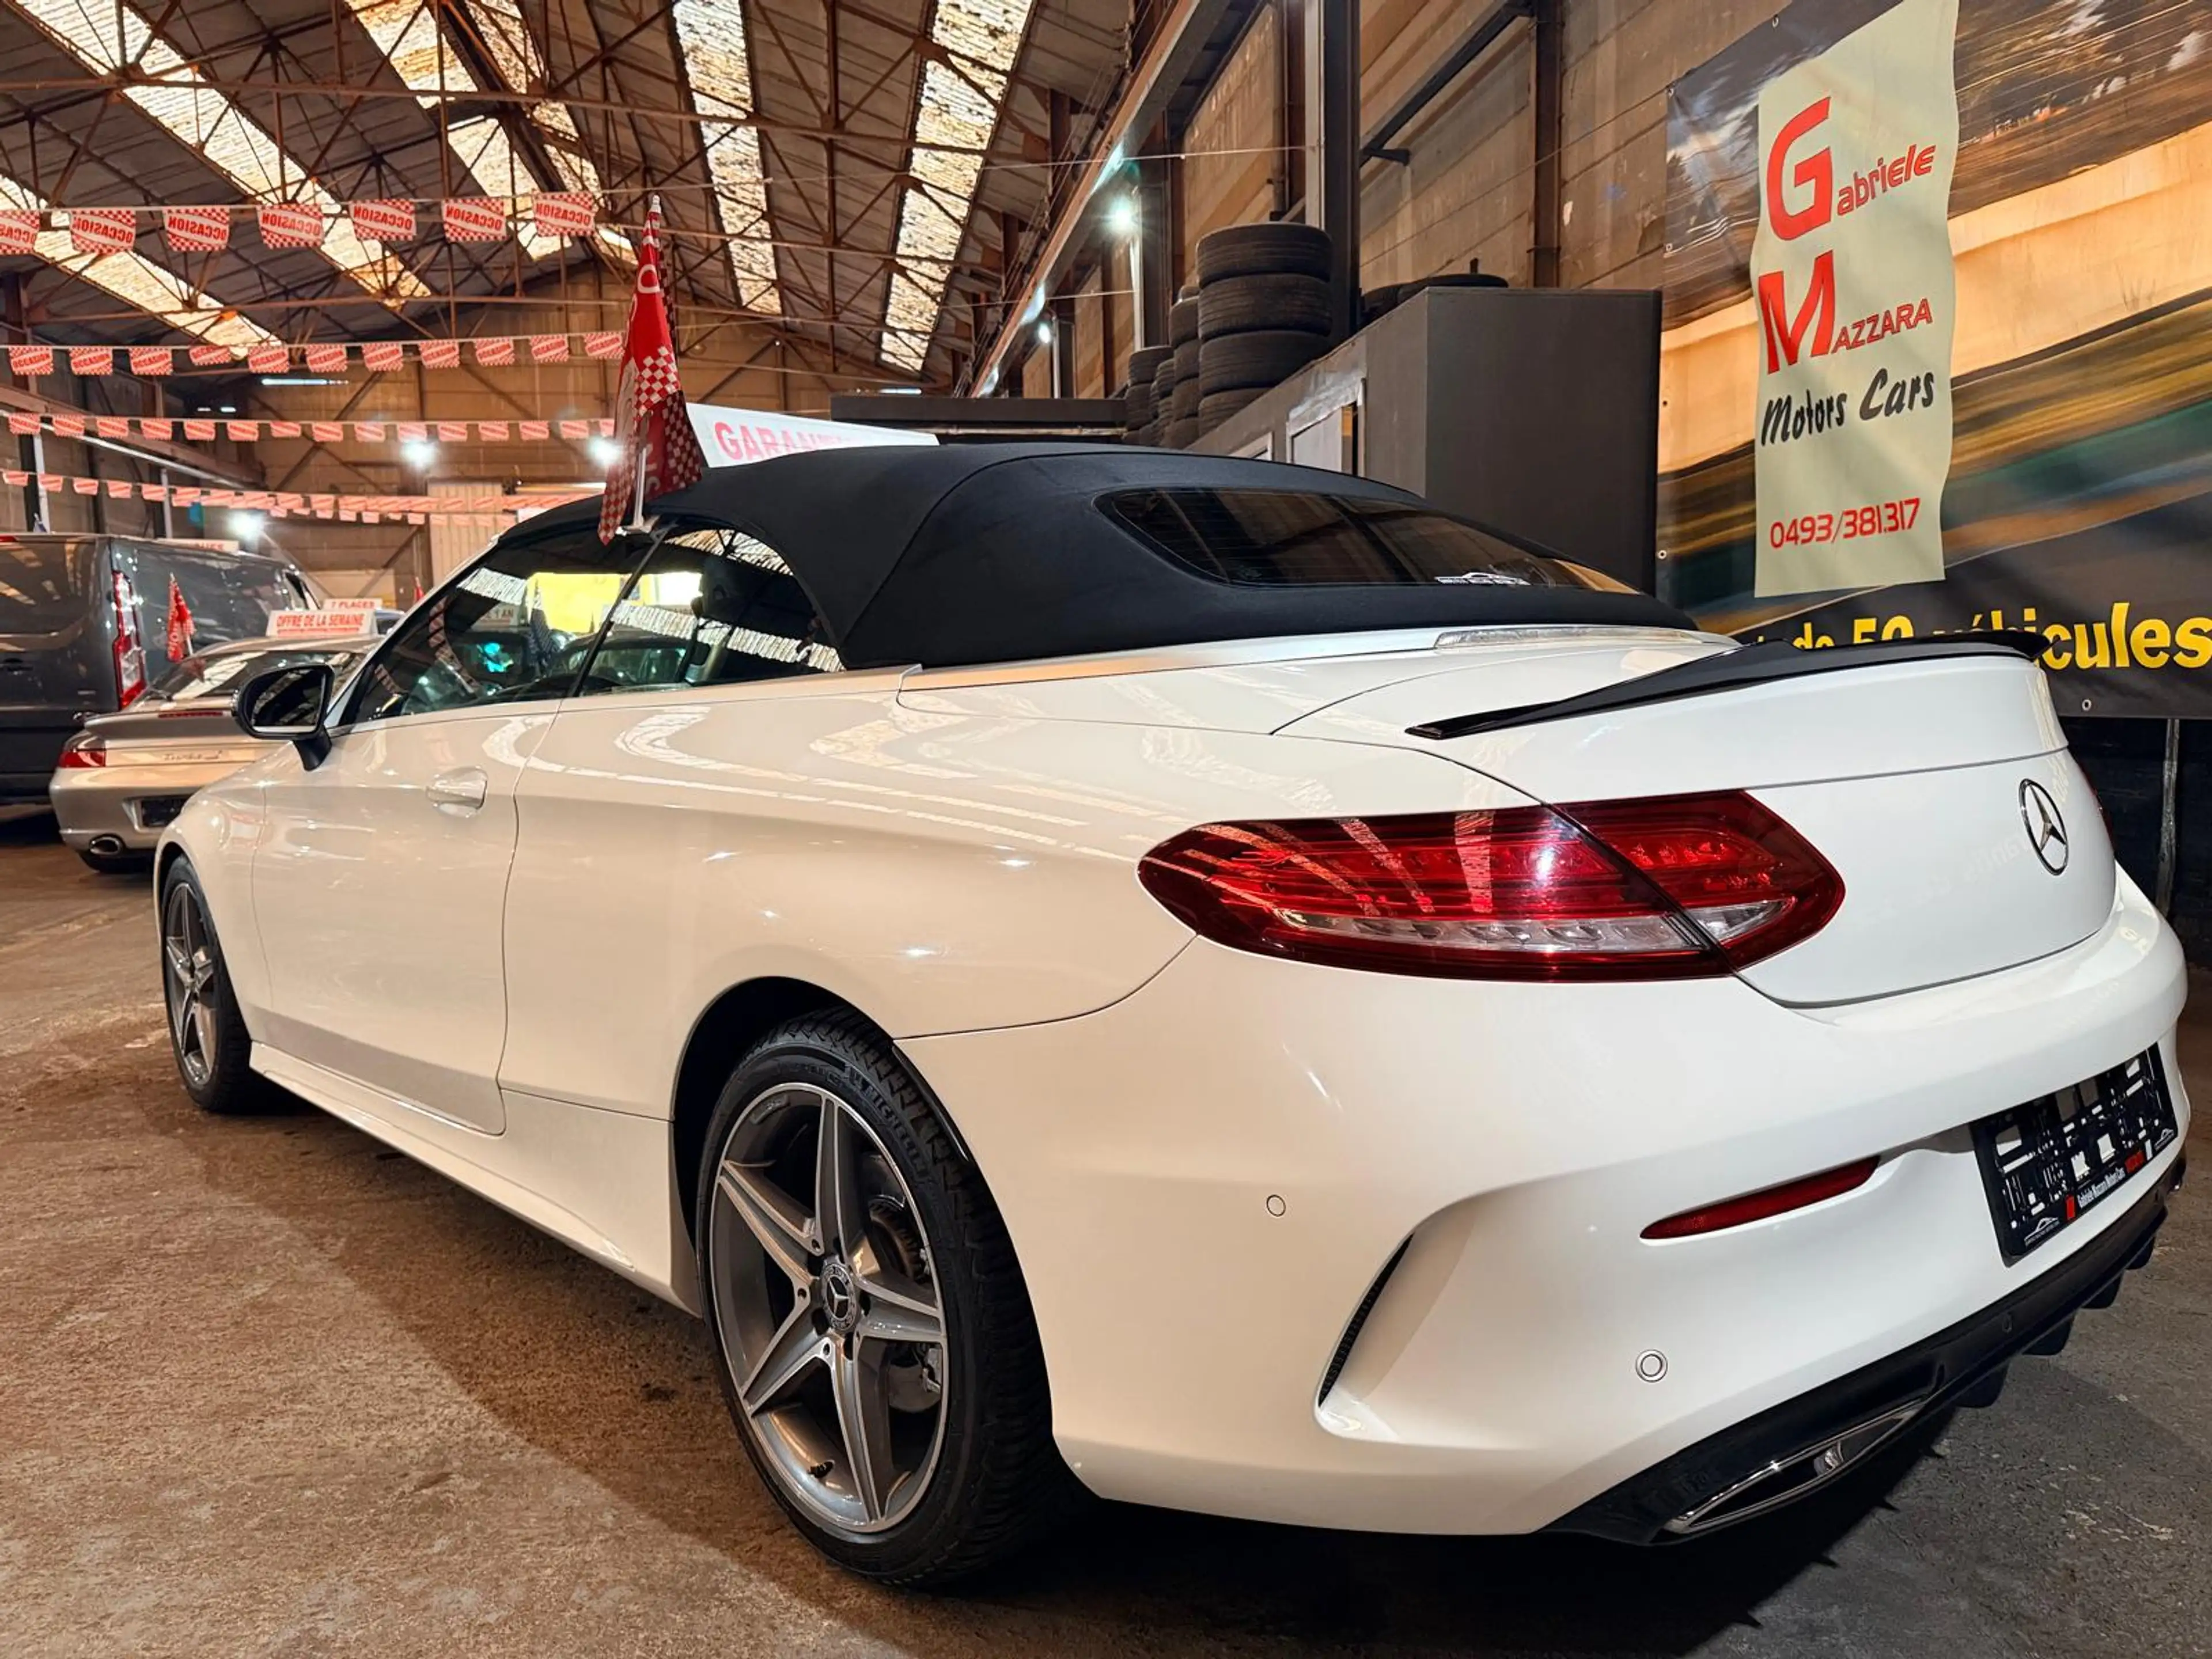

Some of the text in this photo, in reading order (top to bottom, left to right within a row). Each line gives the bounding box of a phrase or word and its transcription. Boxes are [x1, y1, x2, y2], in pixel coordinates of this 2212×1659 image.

[1766, 96, 1936, 241] Gabriele
[1758, 249, 1933, 375] MAZZARA
[1761, 368, 1934, 446] Motors Cars
[1770, 497, 1921, 549] 0493/381.317
[1933, 603, 2212, 669] icules
